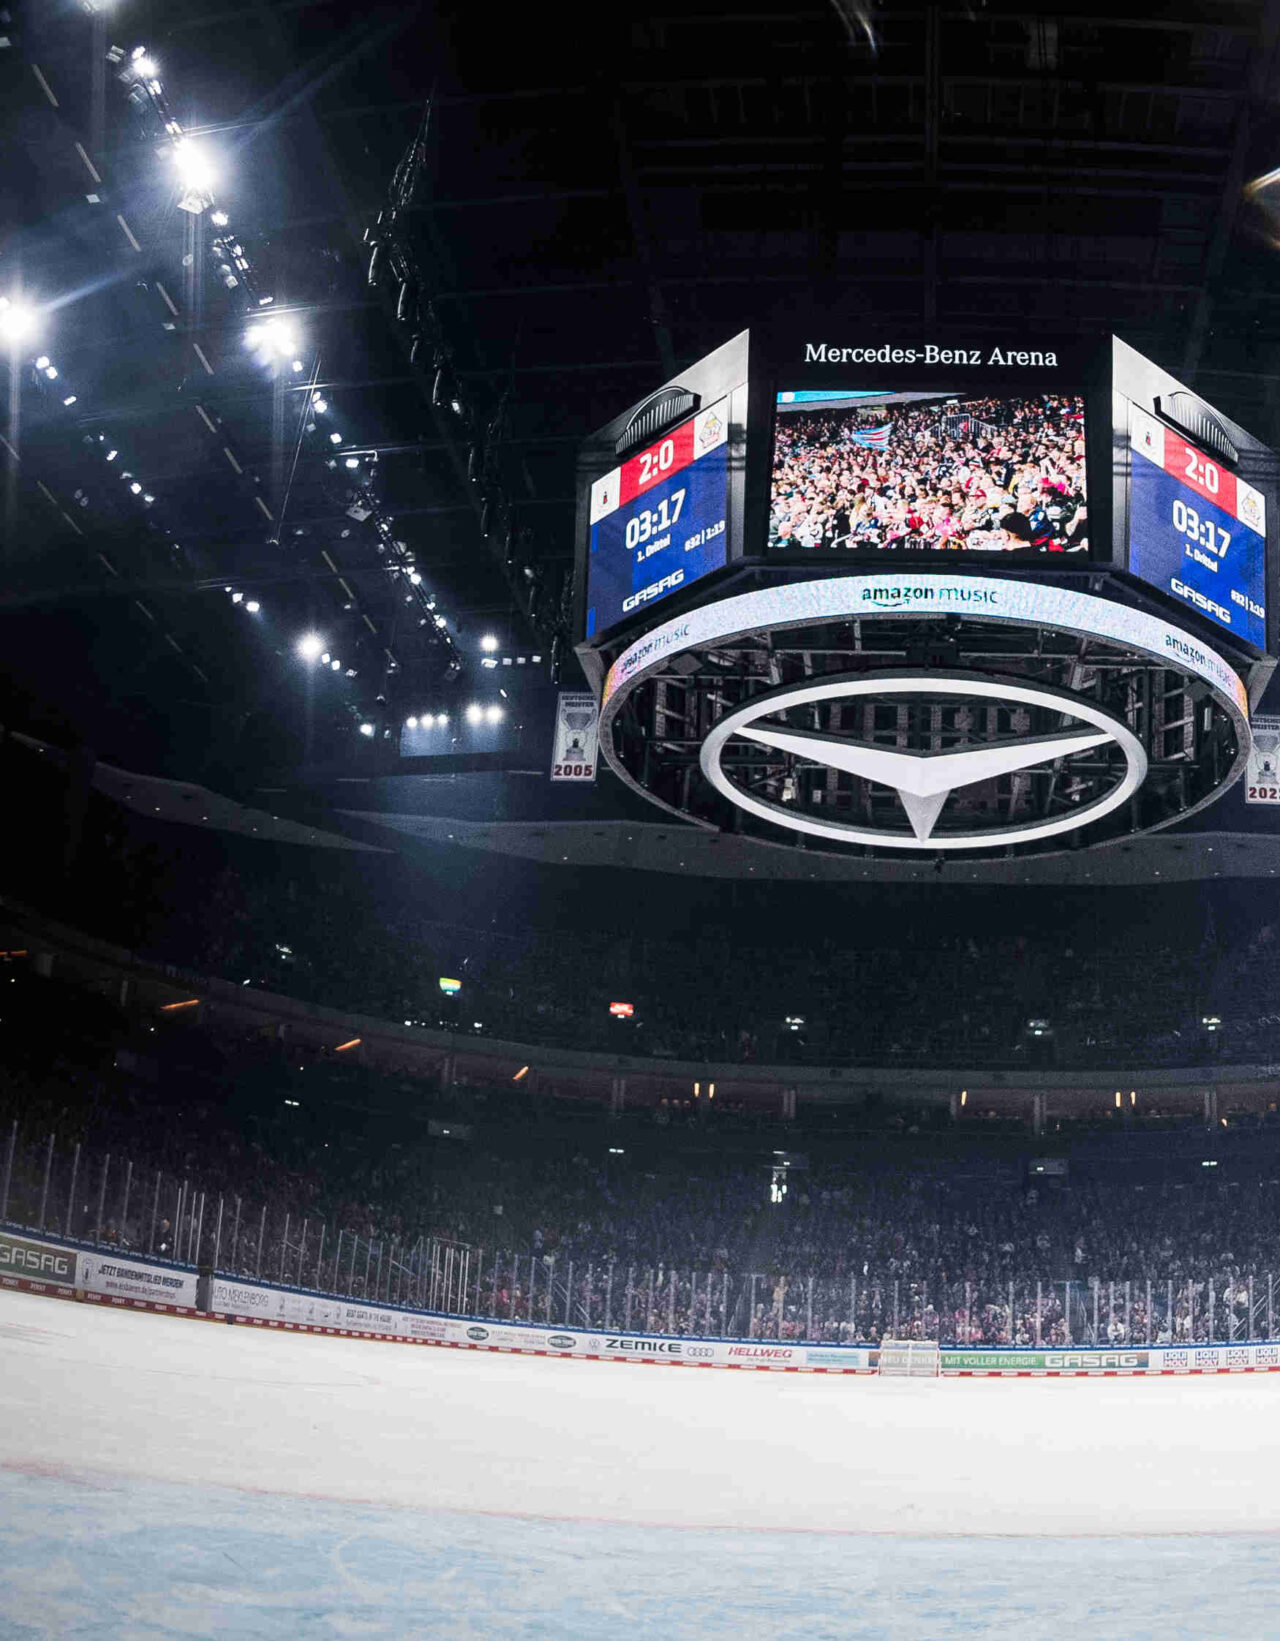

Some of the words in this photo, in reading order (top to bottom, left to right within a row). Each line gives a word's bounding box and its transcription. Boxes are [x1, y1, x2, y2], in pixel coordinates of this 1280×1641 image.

[805, 344, 980, 365] Mercedes-Benz
[987, 348, 1058, 366] Arena
[638, 439, 674, 485] 2:0
[1184, 447, 1219, 494] 2:0
[625, 488, 686, 550] 03:17
[1172, 499, 1231, 559] 03:17
[622, 568, 685, 612] GASAG
[862, 587, 934, 600] amazon
[940, 588, 999, 603] music
[1171, 578, 1232, 624] GASAG
[1165, 634, 1205, 664] amazon
[554, 764, 593, 776] 2005
[605, 1338, 682, 1353] ZEMKE
[728, 1346, 793, 1359] HELLWEG
[945, 1356, 960, 1365] MIT
[963, 1356, 995, 1365] VOLLER
[1045, 1354, 1138, 1368] GASAG
